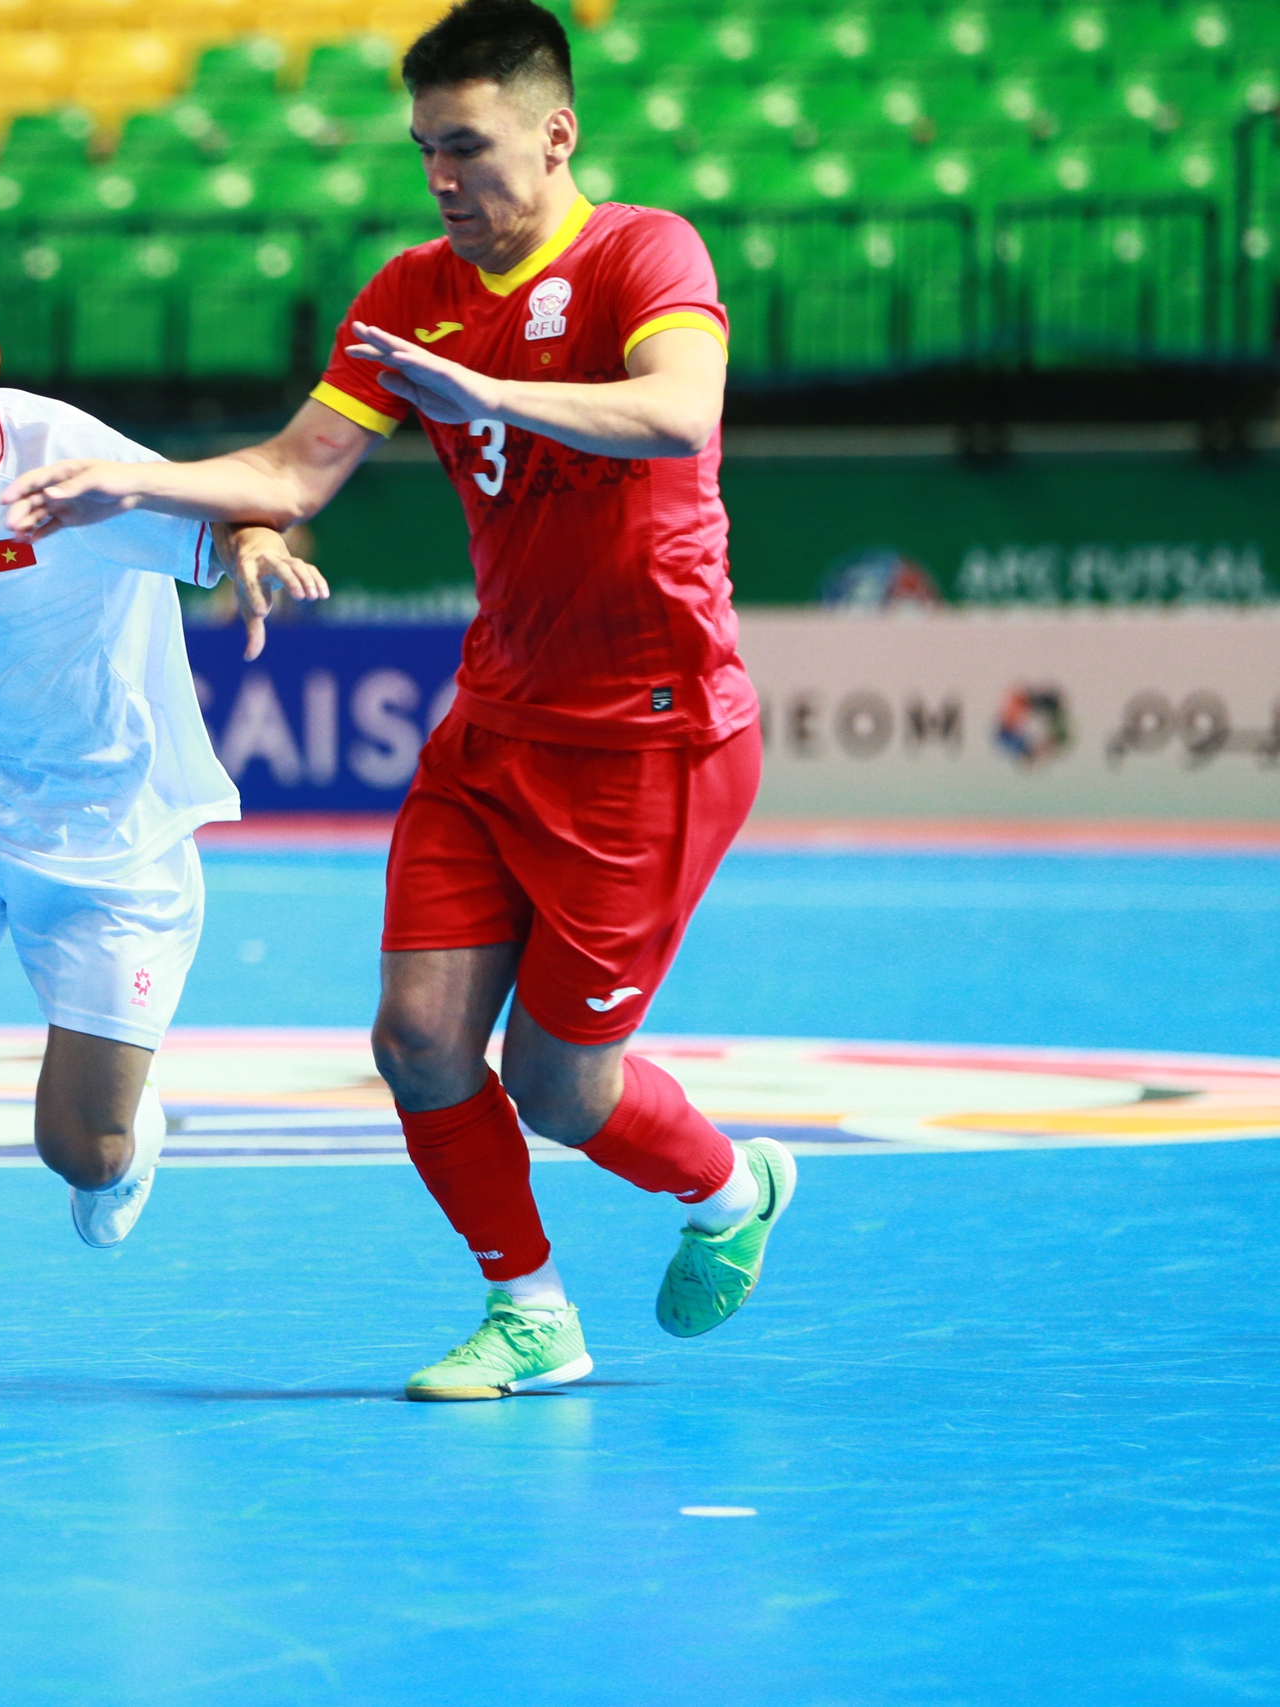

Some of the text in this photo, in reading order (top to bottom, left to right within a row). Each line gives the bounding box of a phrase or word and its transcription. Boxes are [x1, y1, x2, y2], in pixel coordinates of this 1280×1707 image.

[528, 320, 564, 338] KFU
[469, 418, 508, 497] 3
[193, 668, 460, 789] AIS
